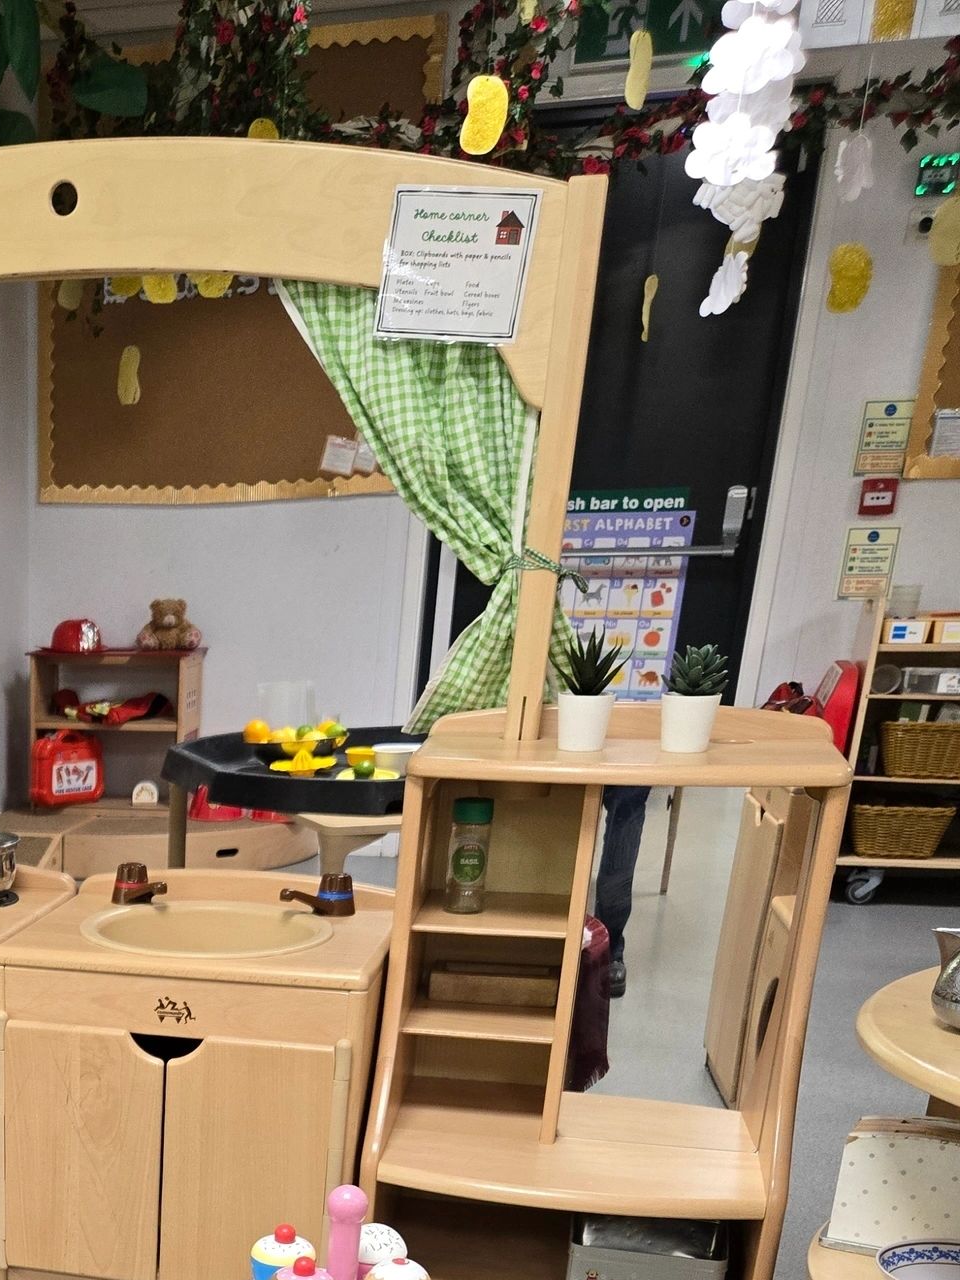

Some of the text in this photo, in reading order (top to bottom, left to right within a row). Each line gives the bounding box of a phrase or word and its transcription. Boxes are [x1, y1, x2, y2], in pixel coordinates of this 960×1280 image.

[414, 208, 490, 222] Home corner
[421, 230, 479, 244] Checklist
[416, 250, 449, 260] Clipboards
[450, 251, 464, 259] with
[464, 253, 483, 262] paper
[490, 253, 512, 263] pencils
[399, 258, 451, 269] for shopping lists
[465, 281, 480, 289] Food
[424, 289, 439, 297] Fruit
[567, 496, 685, 512] sh bar to open
[564, 517, 674, 532] RST ALPHABET
